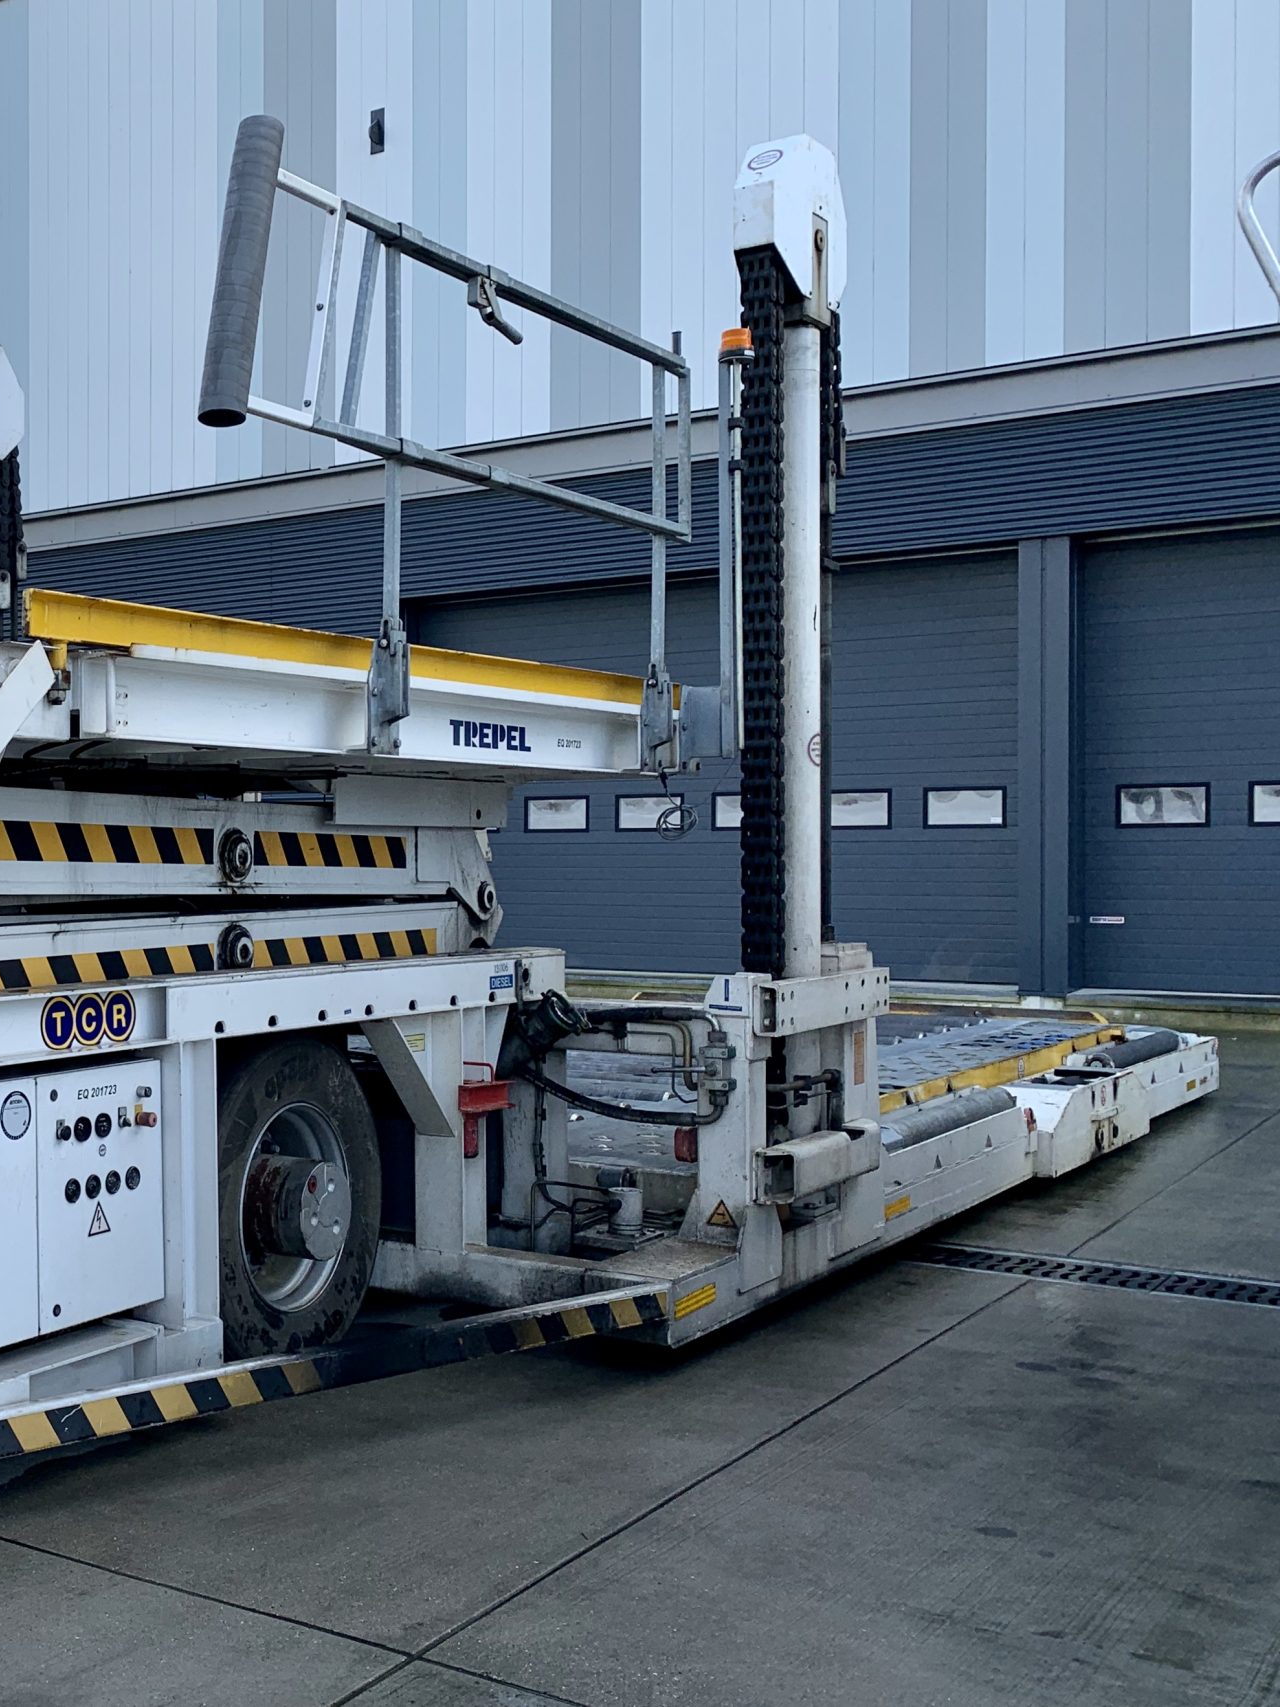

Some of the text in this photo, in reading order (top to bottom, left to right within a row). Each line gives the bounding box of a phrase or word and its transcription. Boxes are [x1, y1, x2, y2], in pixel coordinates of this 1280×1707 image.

[449, 719, 531, 752] TREPEL
[491, 976, 512, 988] DIESEL
[77, 1084, 117, 1100] EQ 201723
